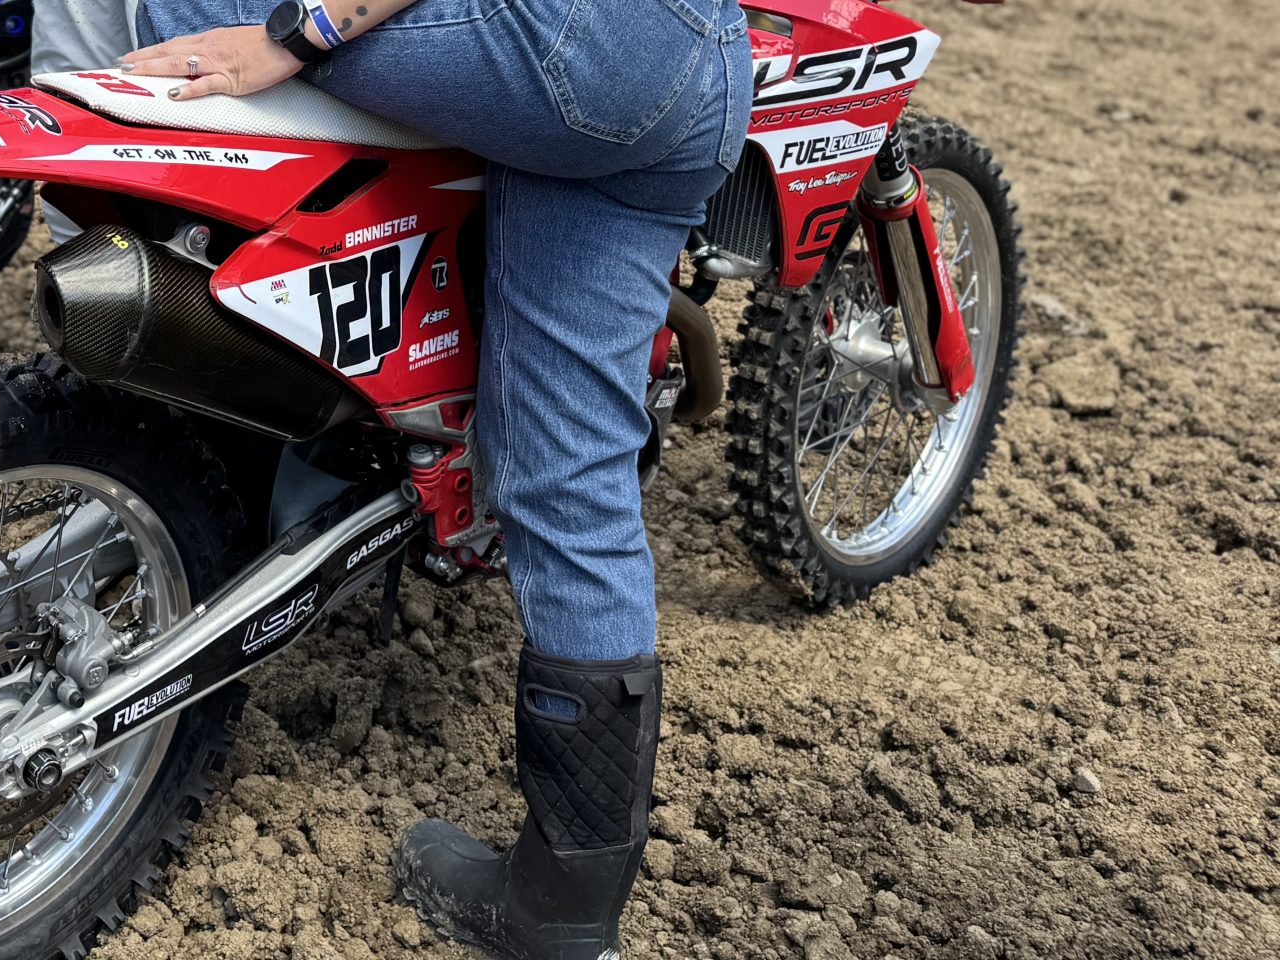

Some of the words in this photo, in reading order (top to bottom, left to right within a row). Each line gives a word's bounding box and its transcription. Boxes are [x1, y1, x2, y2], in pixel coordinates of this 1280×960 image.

[752, 35, 918, 108] LSR
[750, 86, 913, 128] MOTORSPORTS
[112, 147, 144, 160] GET
[153, 148, 178, 161] ON
[183, 149, 216, 163] THE
[223, 151, 249, 165] GAS
[779, 135, 839, 170] FUEL
[829, 124, 887, 153] EVOLUTION
[787, 179, 808, 195] Troy
[808, 177, 825, 190] Lee
[825, 170, 858, 187] Designs
[344, 214, 419, 249] BANNISTER
[308, 244, 402, 370] 120
[408, 329, 460, 363] SLAVENS
[346, 515, 414, 571] GASGAS
[241, 583, 319, 652] LSR
[112, 696, 156, 733] FUEL
[148, 673, 193, 708] EVOLUTION
